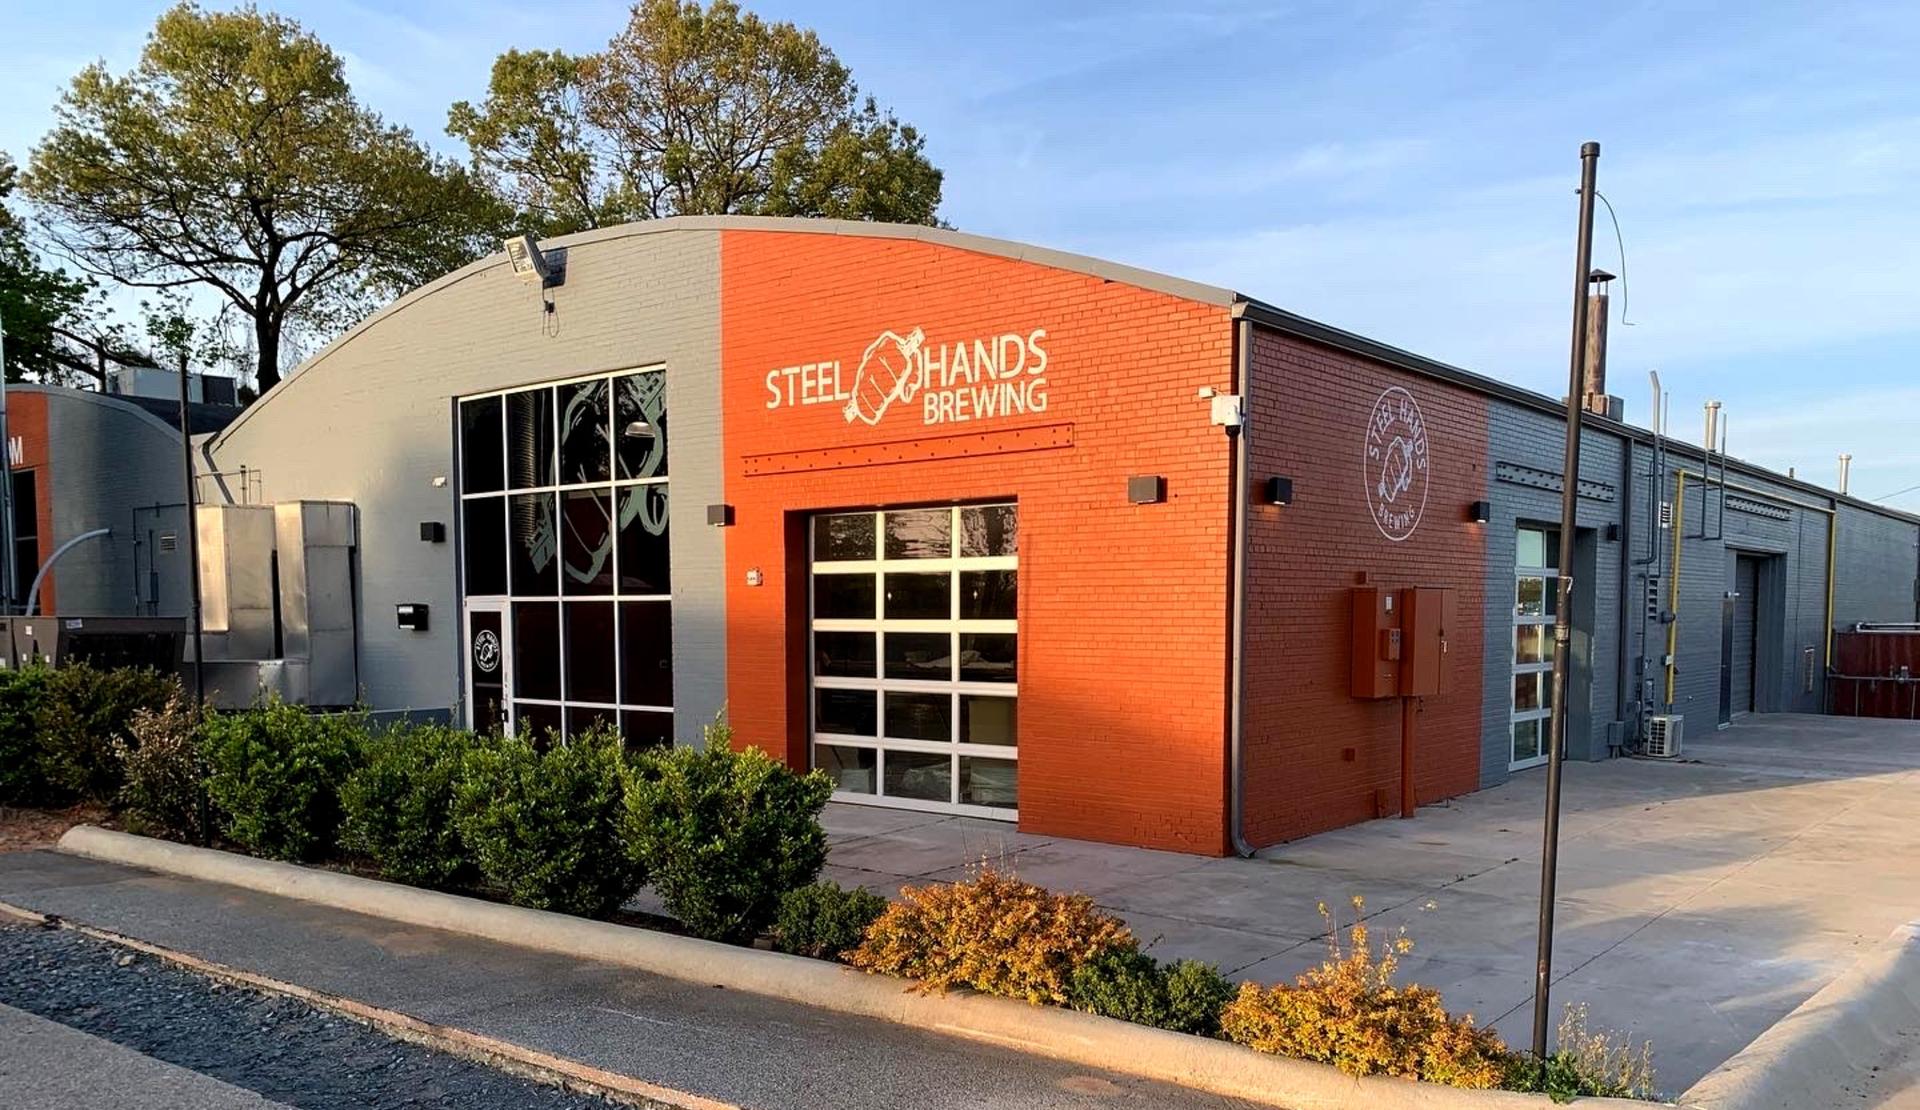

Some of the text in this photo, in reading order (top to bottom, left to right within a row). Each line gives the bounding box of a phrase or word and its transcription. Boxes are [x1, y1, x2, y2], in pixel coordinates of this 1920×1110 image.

[766, 328, 1048, 409] STEEL HANDS
[923, 378, 1048, 425] BREWING
[1368, 398, 1426, 470] STEEL HANDS
[1378, 502, 1415, 530] BREWING
